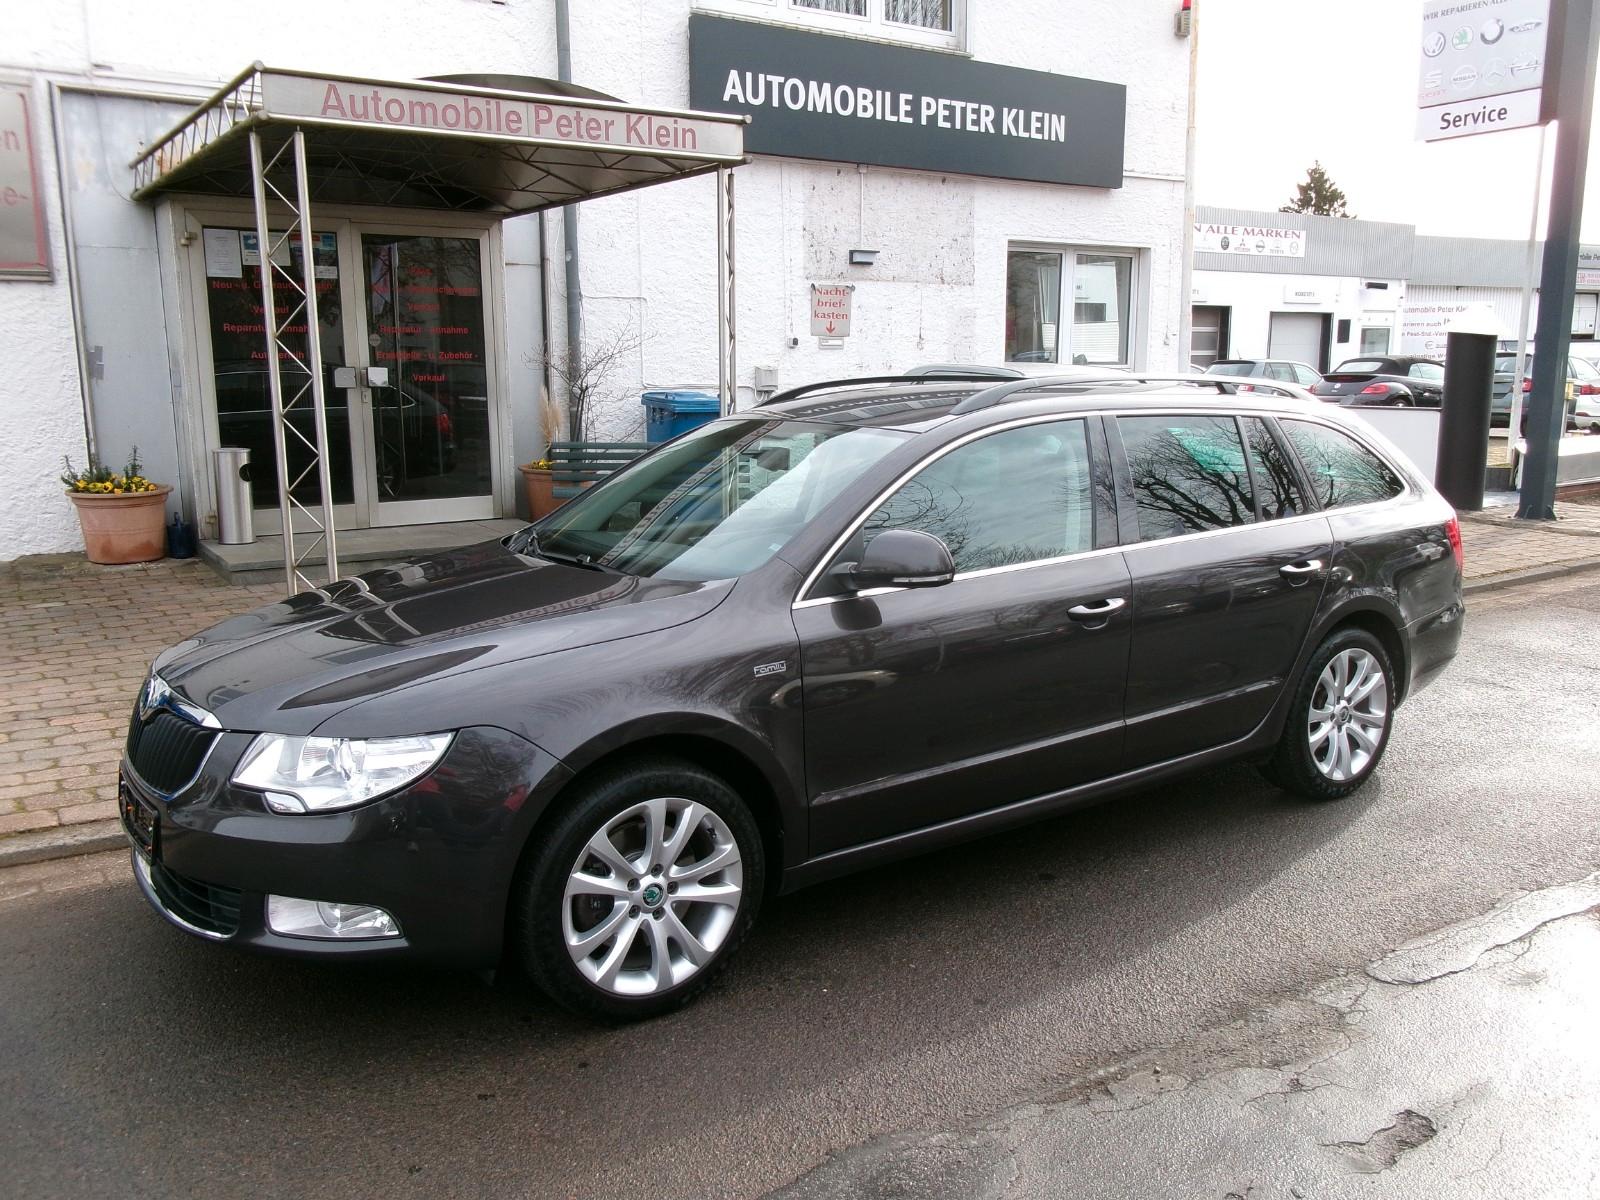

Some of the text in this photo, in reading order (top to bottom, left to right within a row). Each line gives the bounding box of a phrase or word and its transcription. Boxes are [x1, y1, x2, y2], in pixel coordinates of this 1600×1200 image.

[722, 69, 1066, 143] AUTOMOBILE PETER KLEIN
[320, 83, 698, 149] Automobile Peter Klein
[1439, 105, 1508, 130] Service
[1205, 224, 1240, 236] ALLE
[1242, 227, 1301, 239] MARKEN
[815, 287, 849, 296] Nacht-
[816, 298, 846, 308] brief-
[813, 309, 848, 320] kasten
